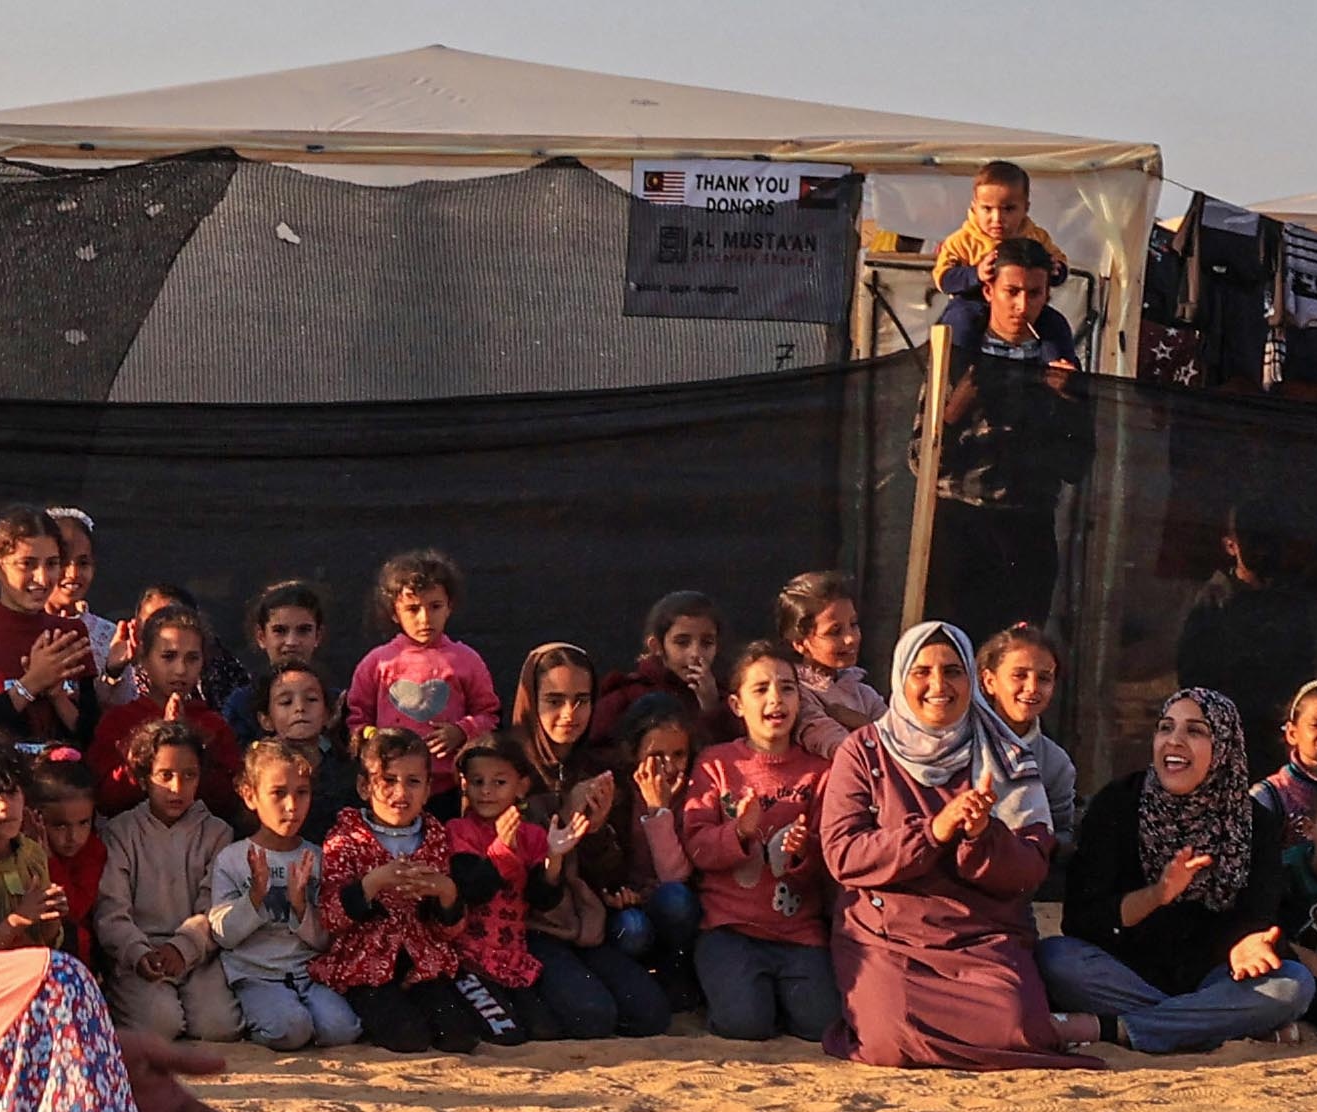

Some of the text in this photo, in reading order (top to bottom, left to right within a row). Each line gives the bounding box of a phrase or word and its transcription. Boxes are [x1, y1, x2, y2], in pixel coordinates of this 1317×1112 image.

[695, 174, 790, 194] THANK YOU
[706, 197, 776, 215] DONORS
[692, 232, 715, 248] AL
[456, 974, 516, 1035] TIME
